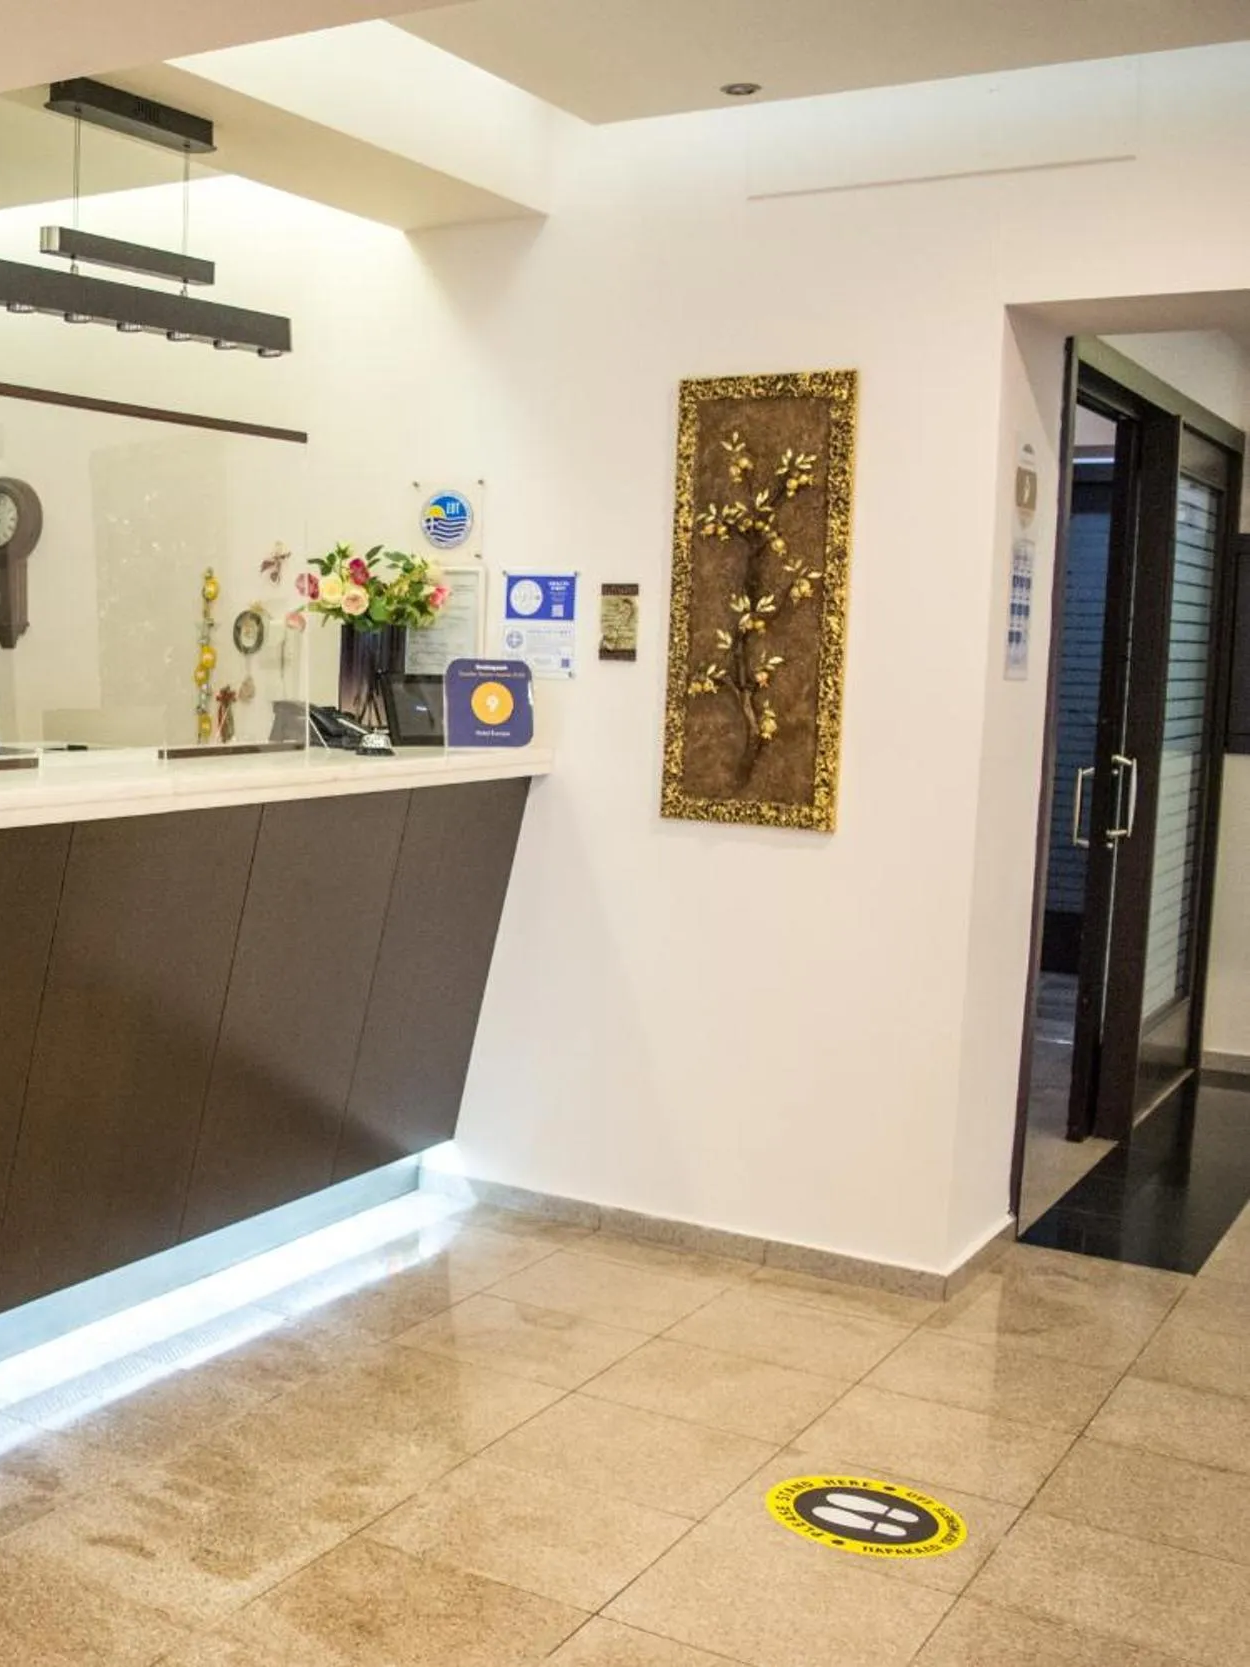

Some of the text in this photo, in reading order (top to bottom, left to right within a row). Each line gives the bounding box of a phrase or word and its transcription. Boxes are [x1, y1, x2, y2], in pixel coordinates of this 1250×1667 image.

[775, 1479, 869, 1537] PLEASE STAND HERE
